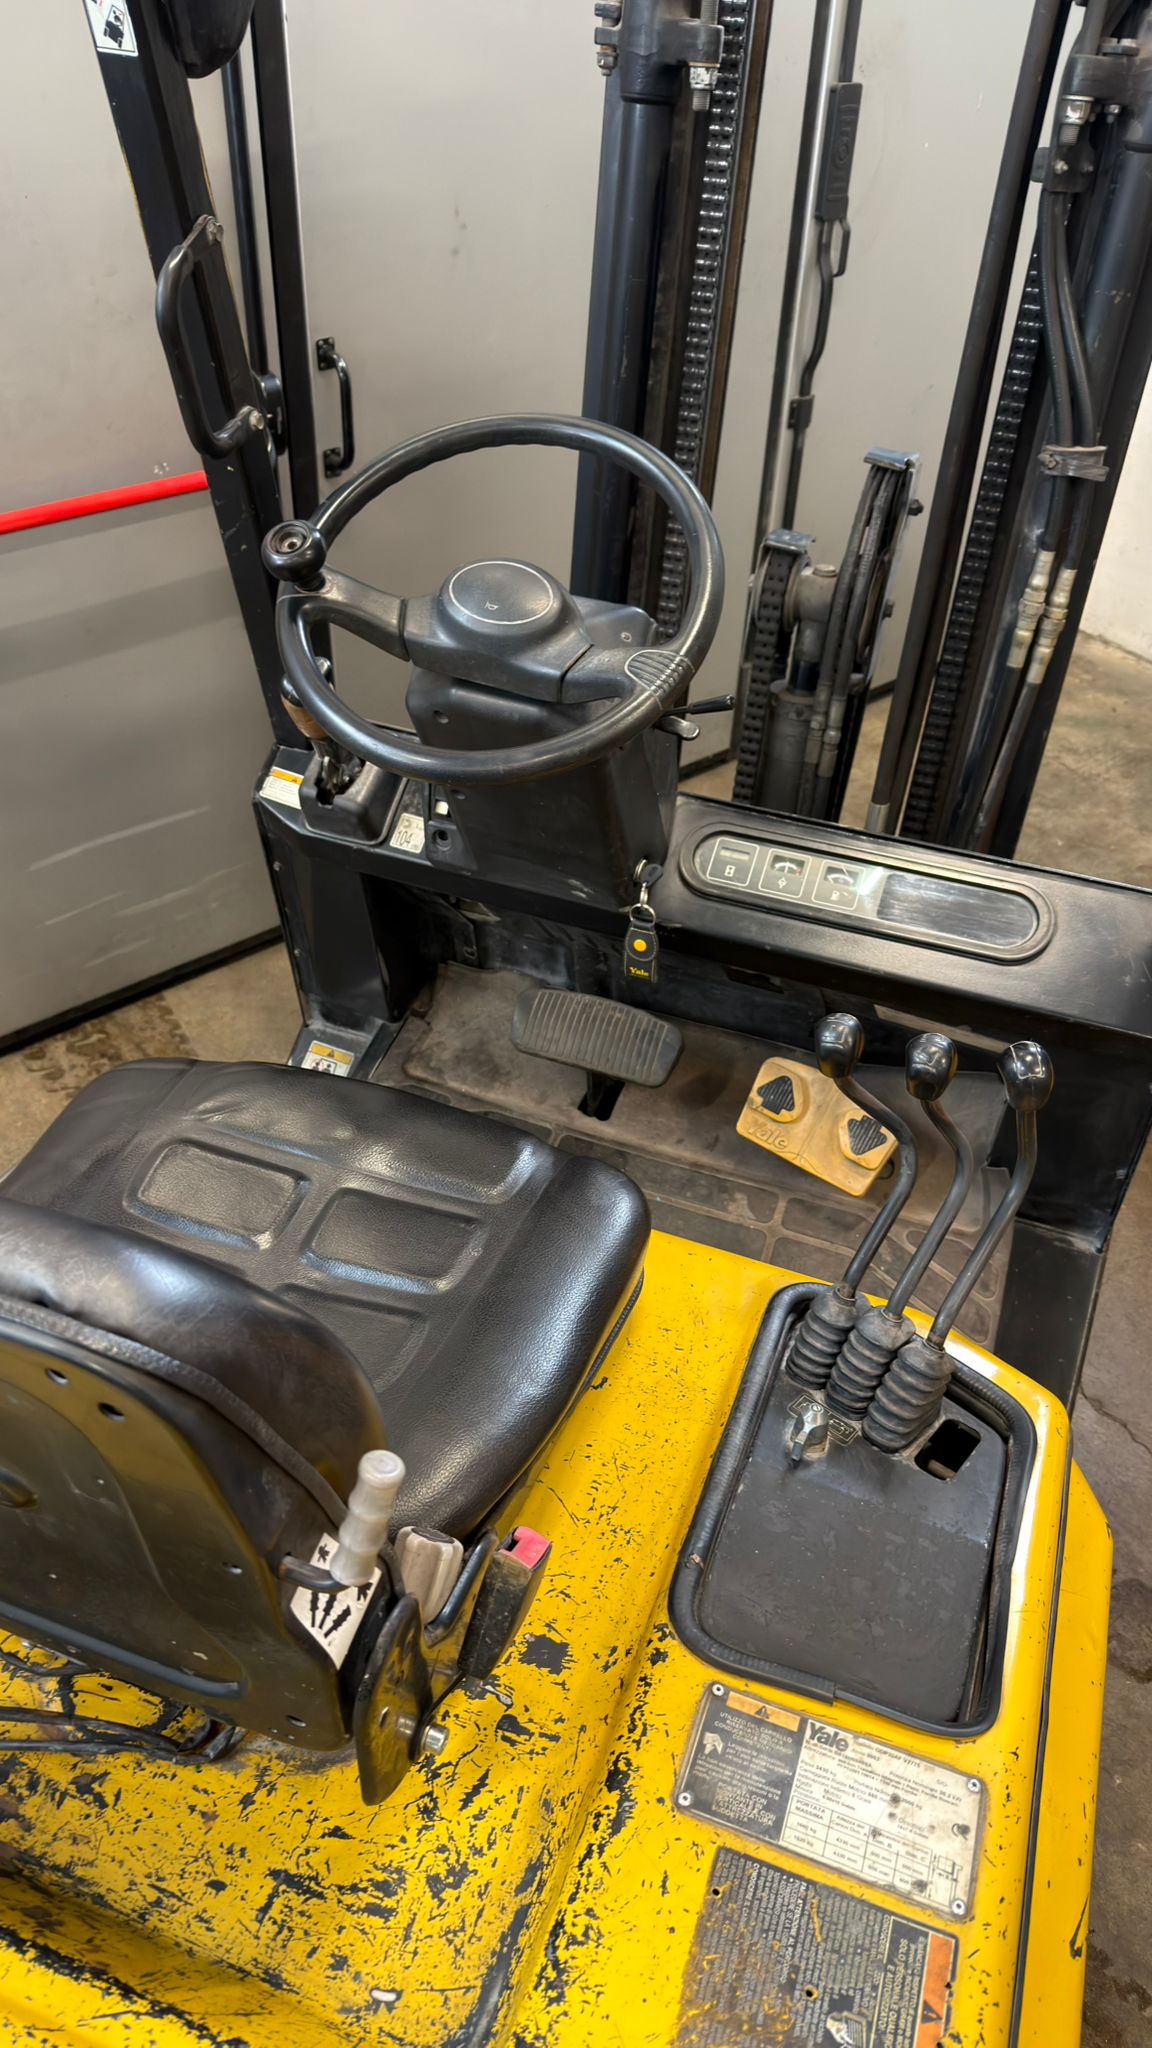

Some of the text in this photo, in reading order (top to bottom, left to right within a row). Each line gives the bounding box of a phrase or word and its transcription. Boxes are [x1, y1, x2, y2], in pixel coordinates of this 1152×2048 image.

[395, 830, 414, 846] 104
[629, 966, 650, 977] Yale
[747, 1119, 789, 1150] Yale
[719, 1711, 746, 1726] UTILIZZO
[759, 1726, 792, 1743] CARRELLO
[806, 1721, 850, 1753] Yale
[717, 1781, 767, 1805] PORTATA CON
[796, 1799, 825, 1814] PORTATA
[759, 1809, 776, 1821] CON
[794, 1805, 824, 1820] MASSIMA
[745, 1862, 760, 1900] CONOSCERE
[789, 1897, 804, 1937] ATTENZIONE
[878, 1913, 890, 1954] CONOSCERE
[897, 1937, 909, 1961] SOLO
[889, 1960, 906, 2011] PERSONALE
